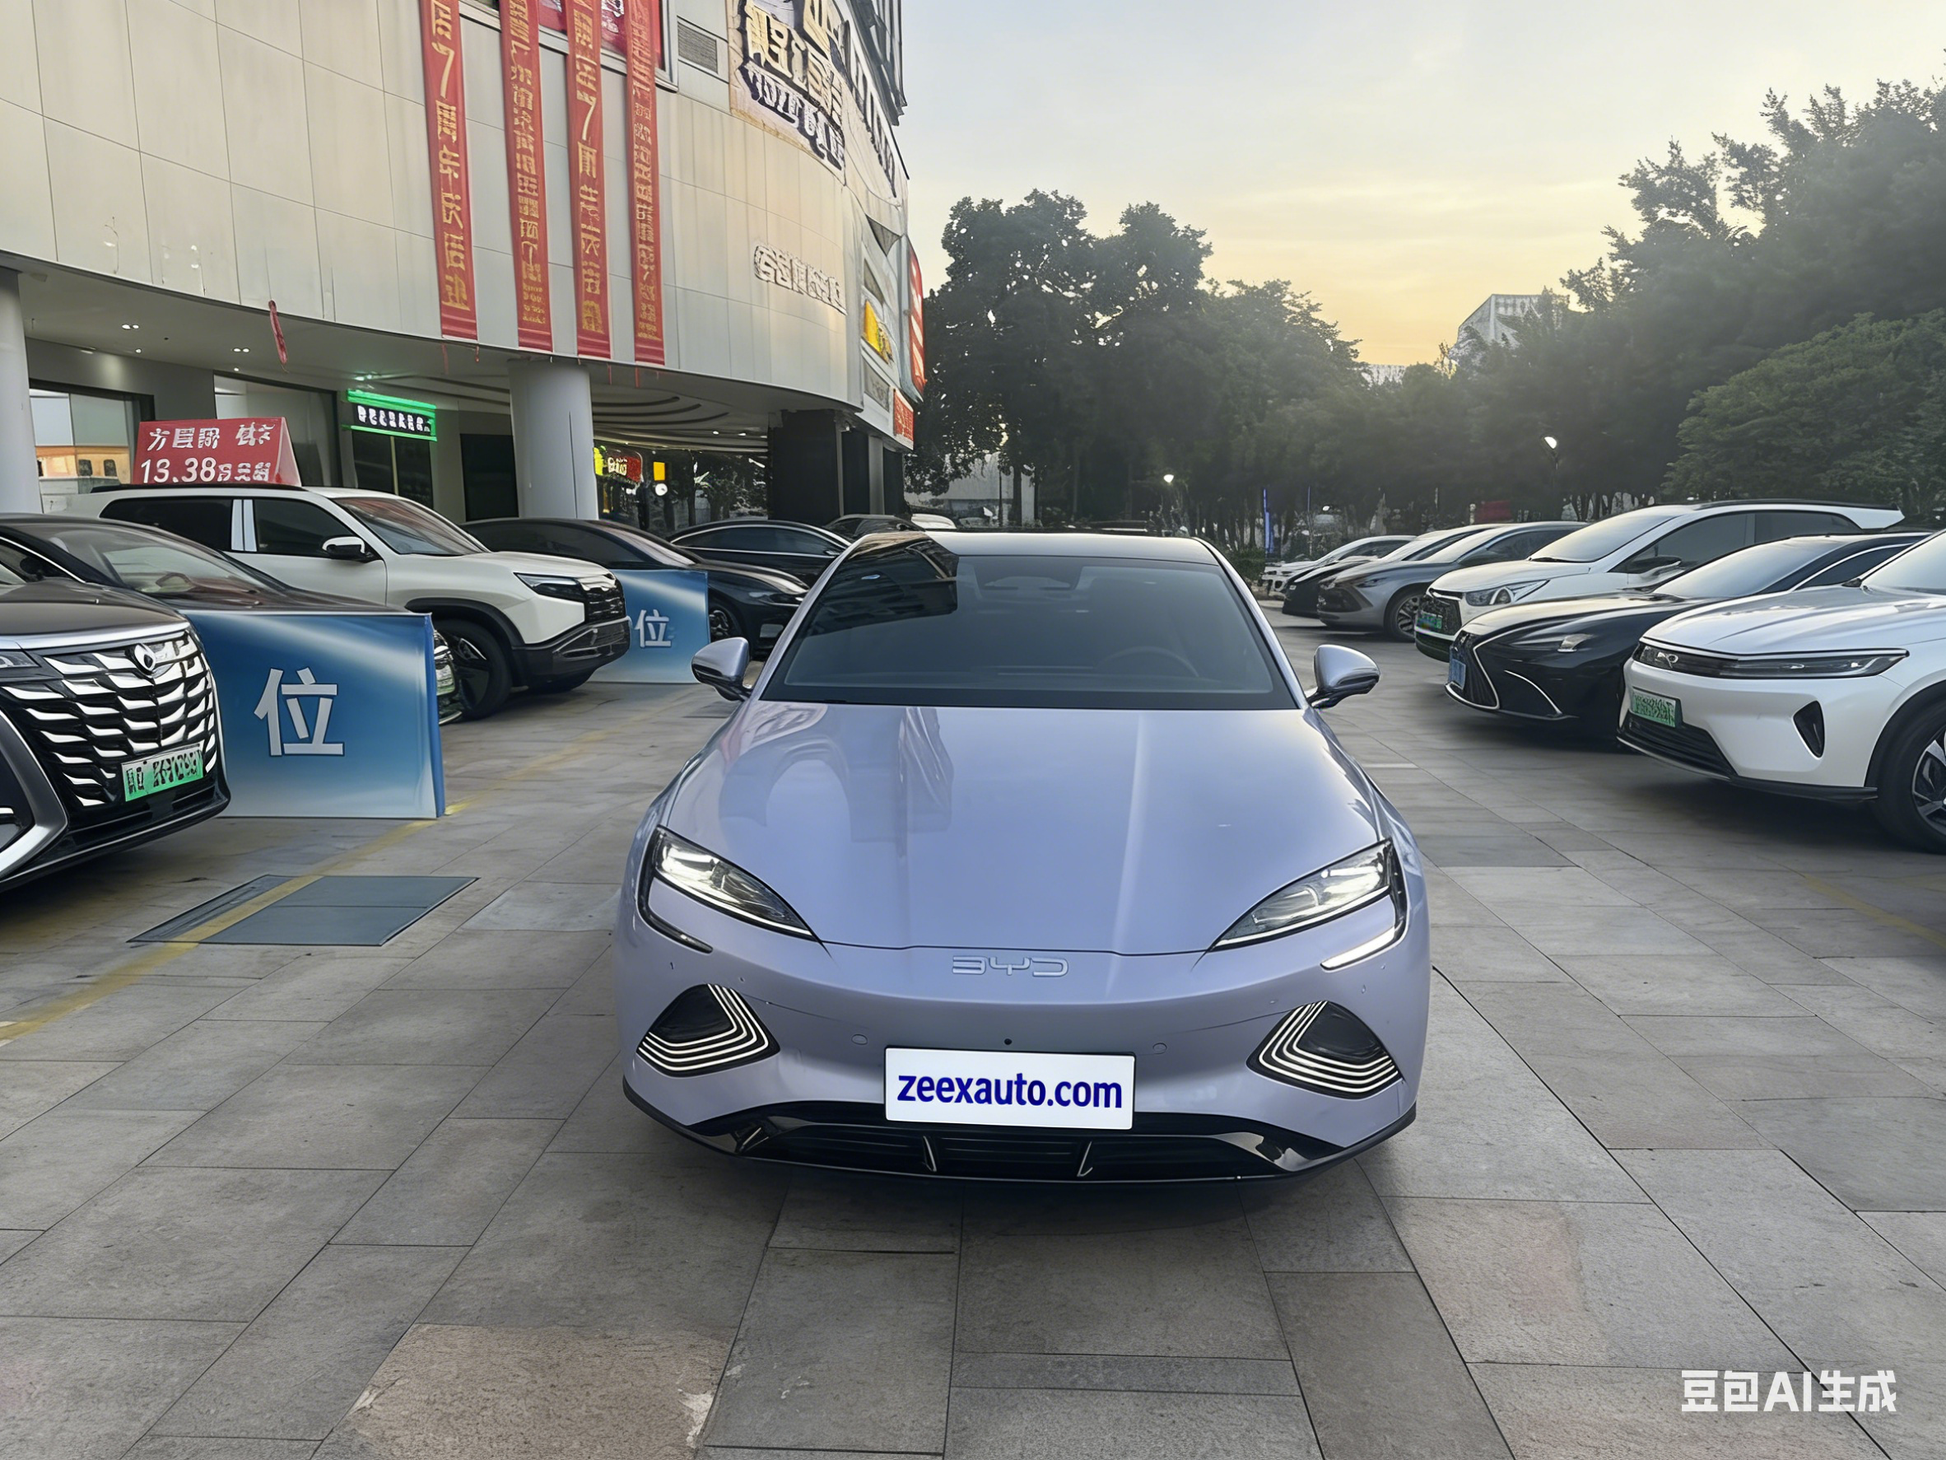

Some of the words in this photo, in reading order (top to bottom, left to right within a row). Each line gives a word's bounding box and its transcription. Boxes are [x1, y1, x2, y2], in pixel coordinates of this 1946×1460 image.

[634, 609, 672, 648] 位
[254, 667, 345, 756] 位
[952, 955, 1069, 977] BYD
[897, 1073, 1122, 1108] zeexauto.com
